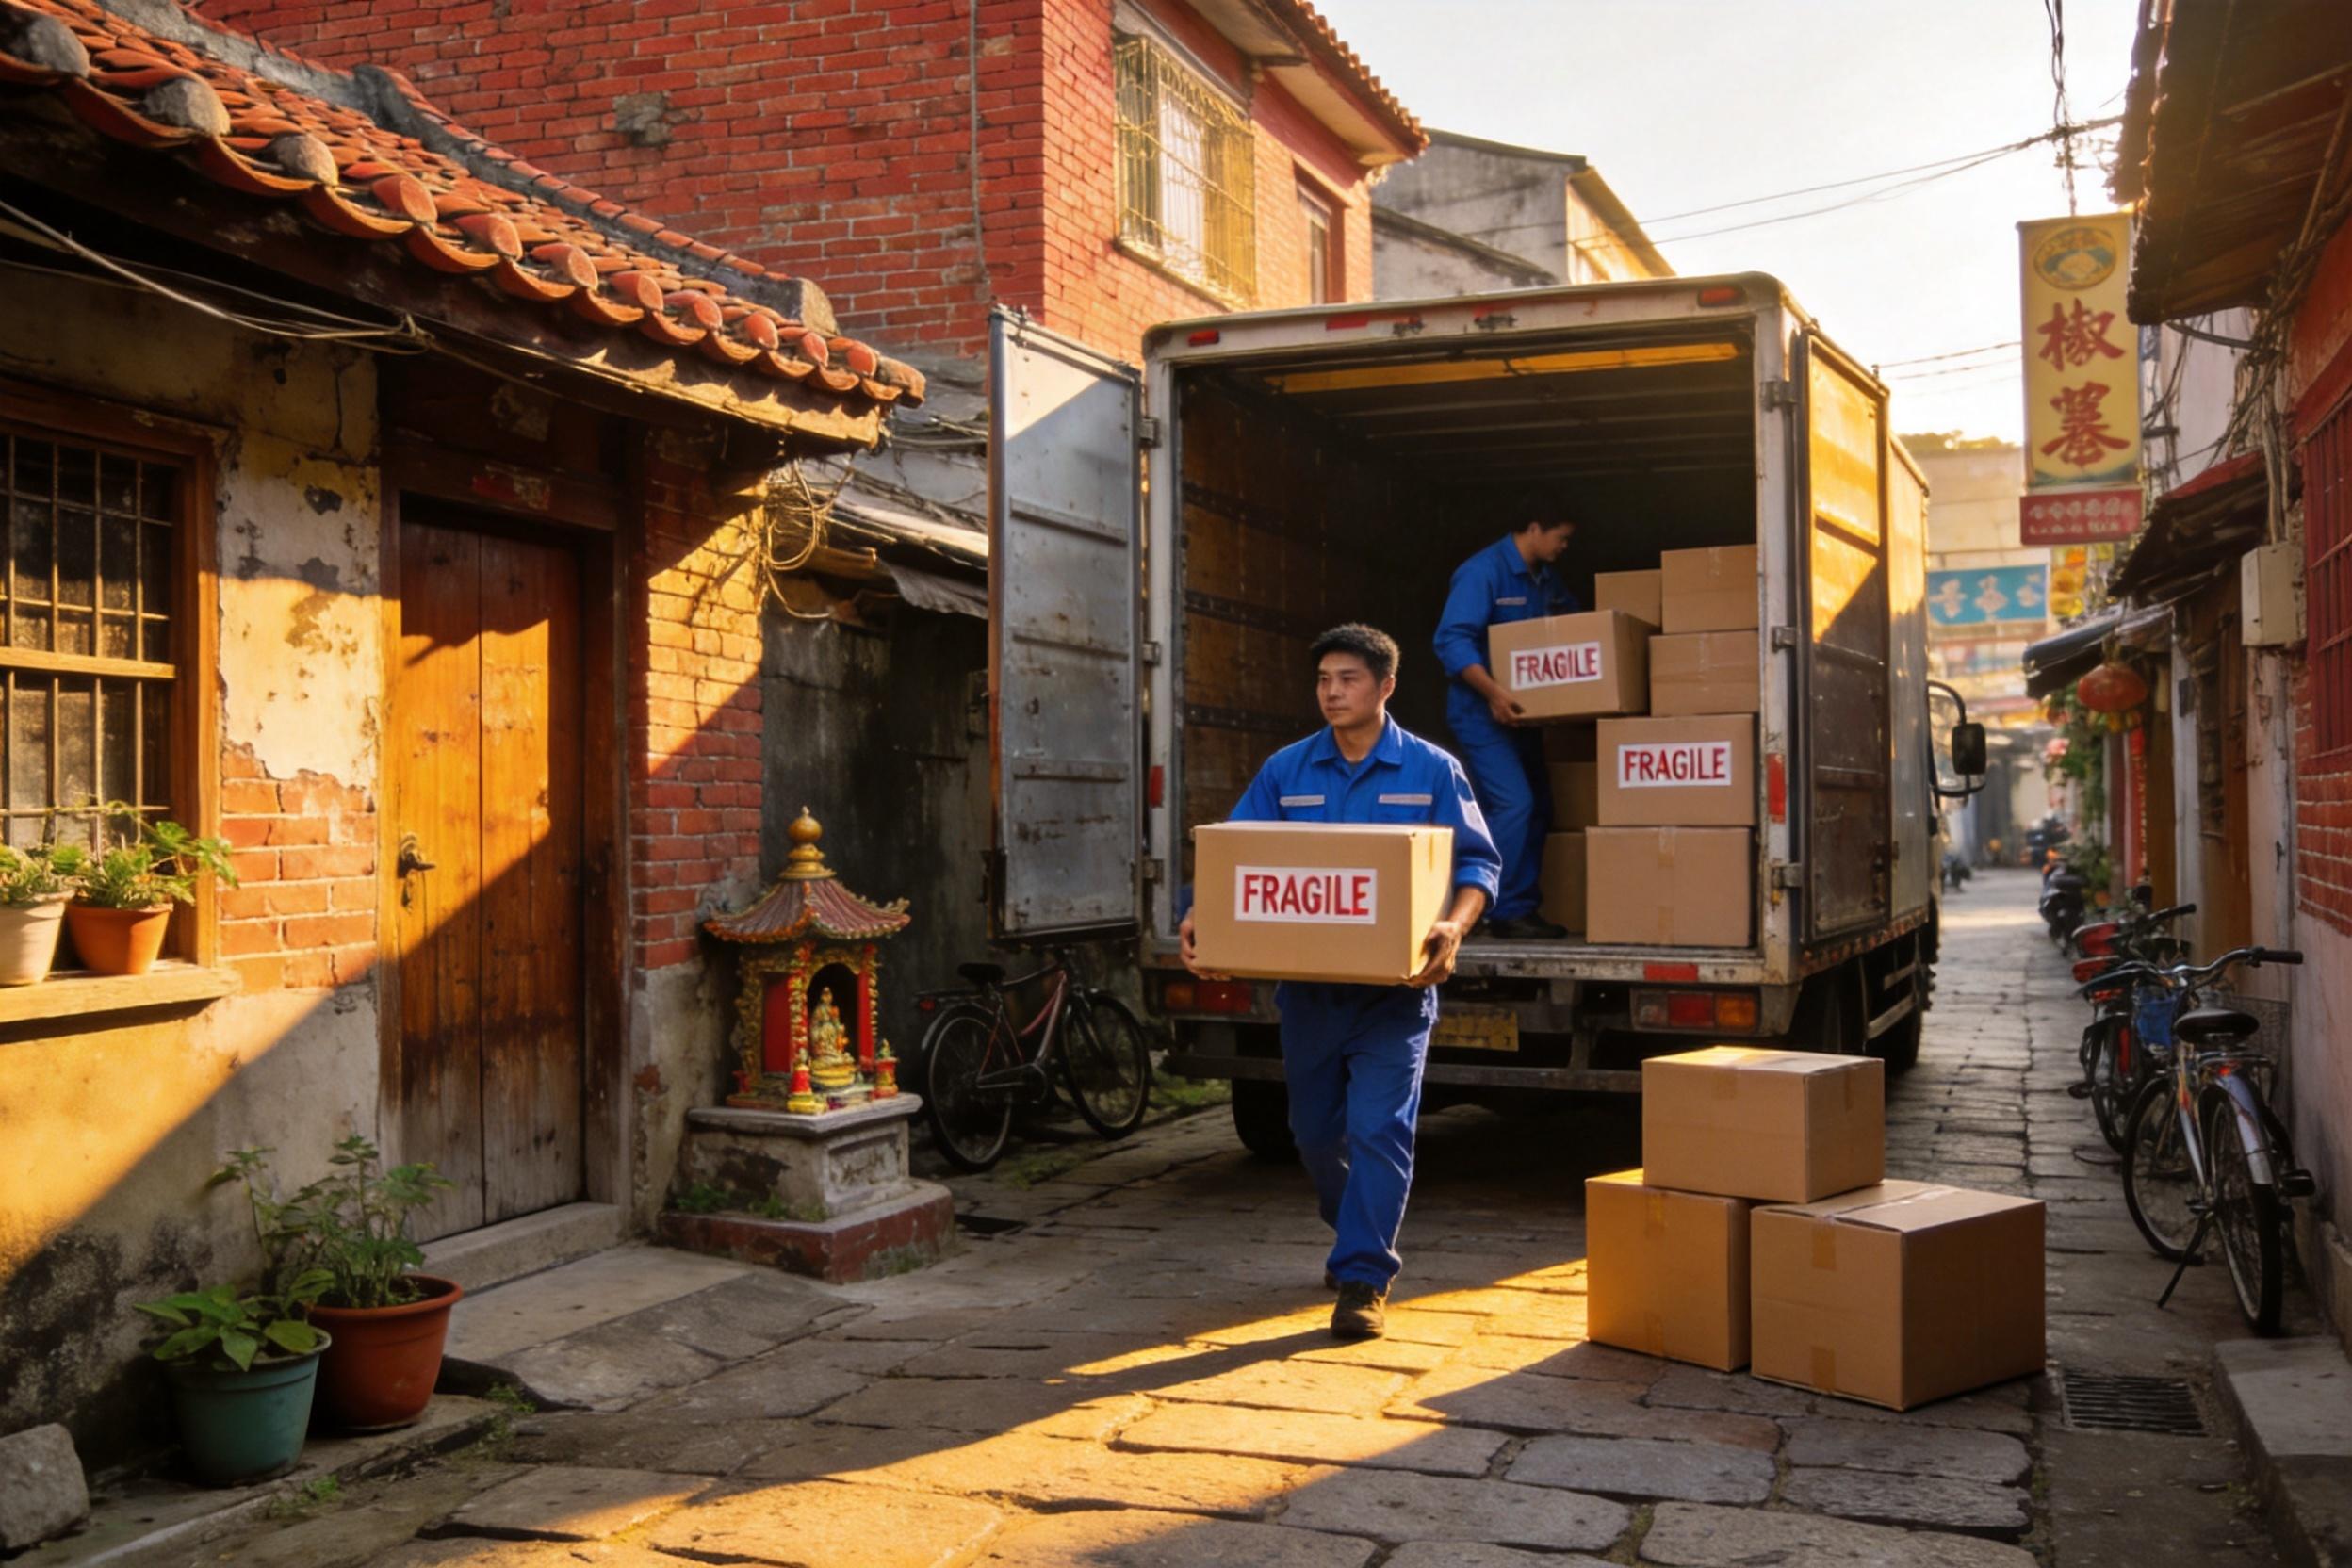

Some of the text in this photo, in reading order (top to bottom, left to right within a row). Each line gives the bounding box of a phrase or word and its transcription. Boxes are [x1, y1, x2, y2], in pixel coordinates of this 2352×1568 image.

[1515, 648, 1598, 684] FRAGILE
[1624, 748, 1726, 781] FRAGILE
[1242, 874, 1371, 916] FRAGILE
